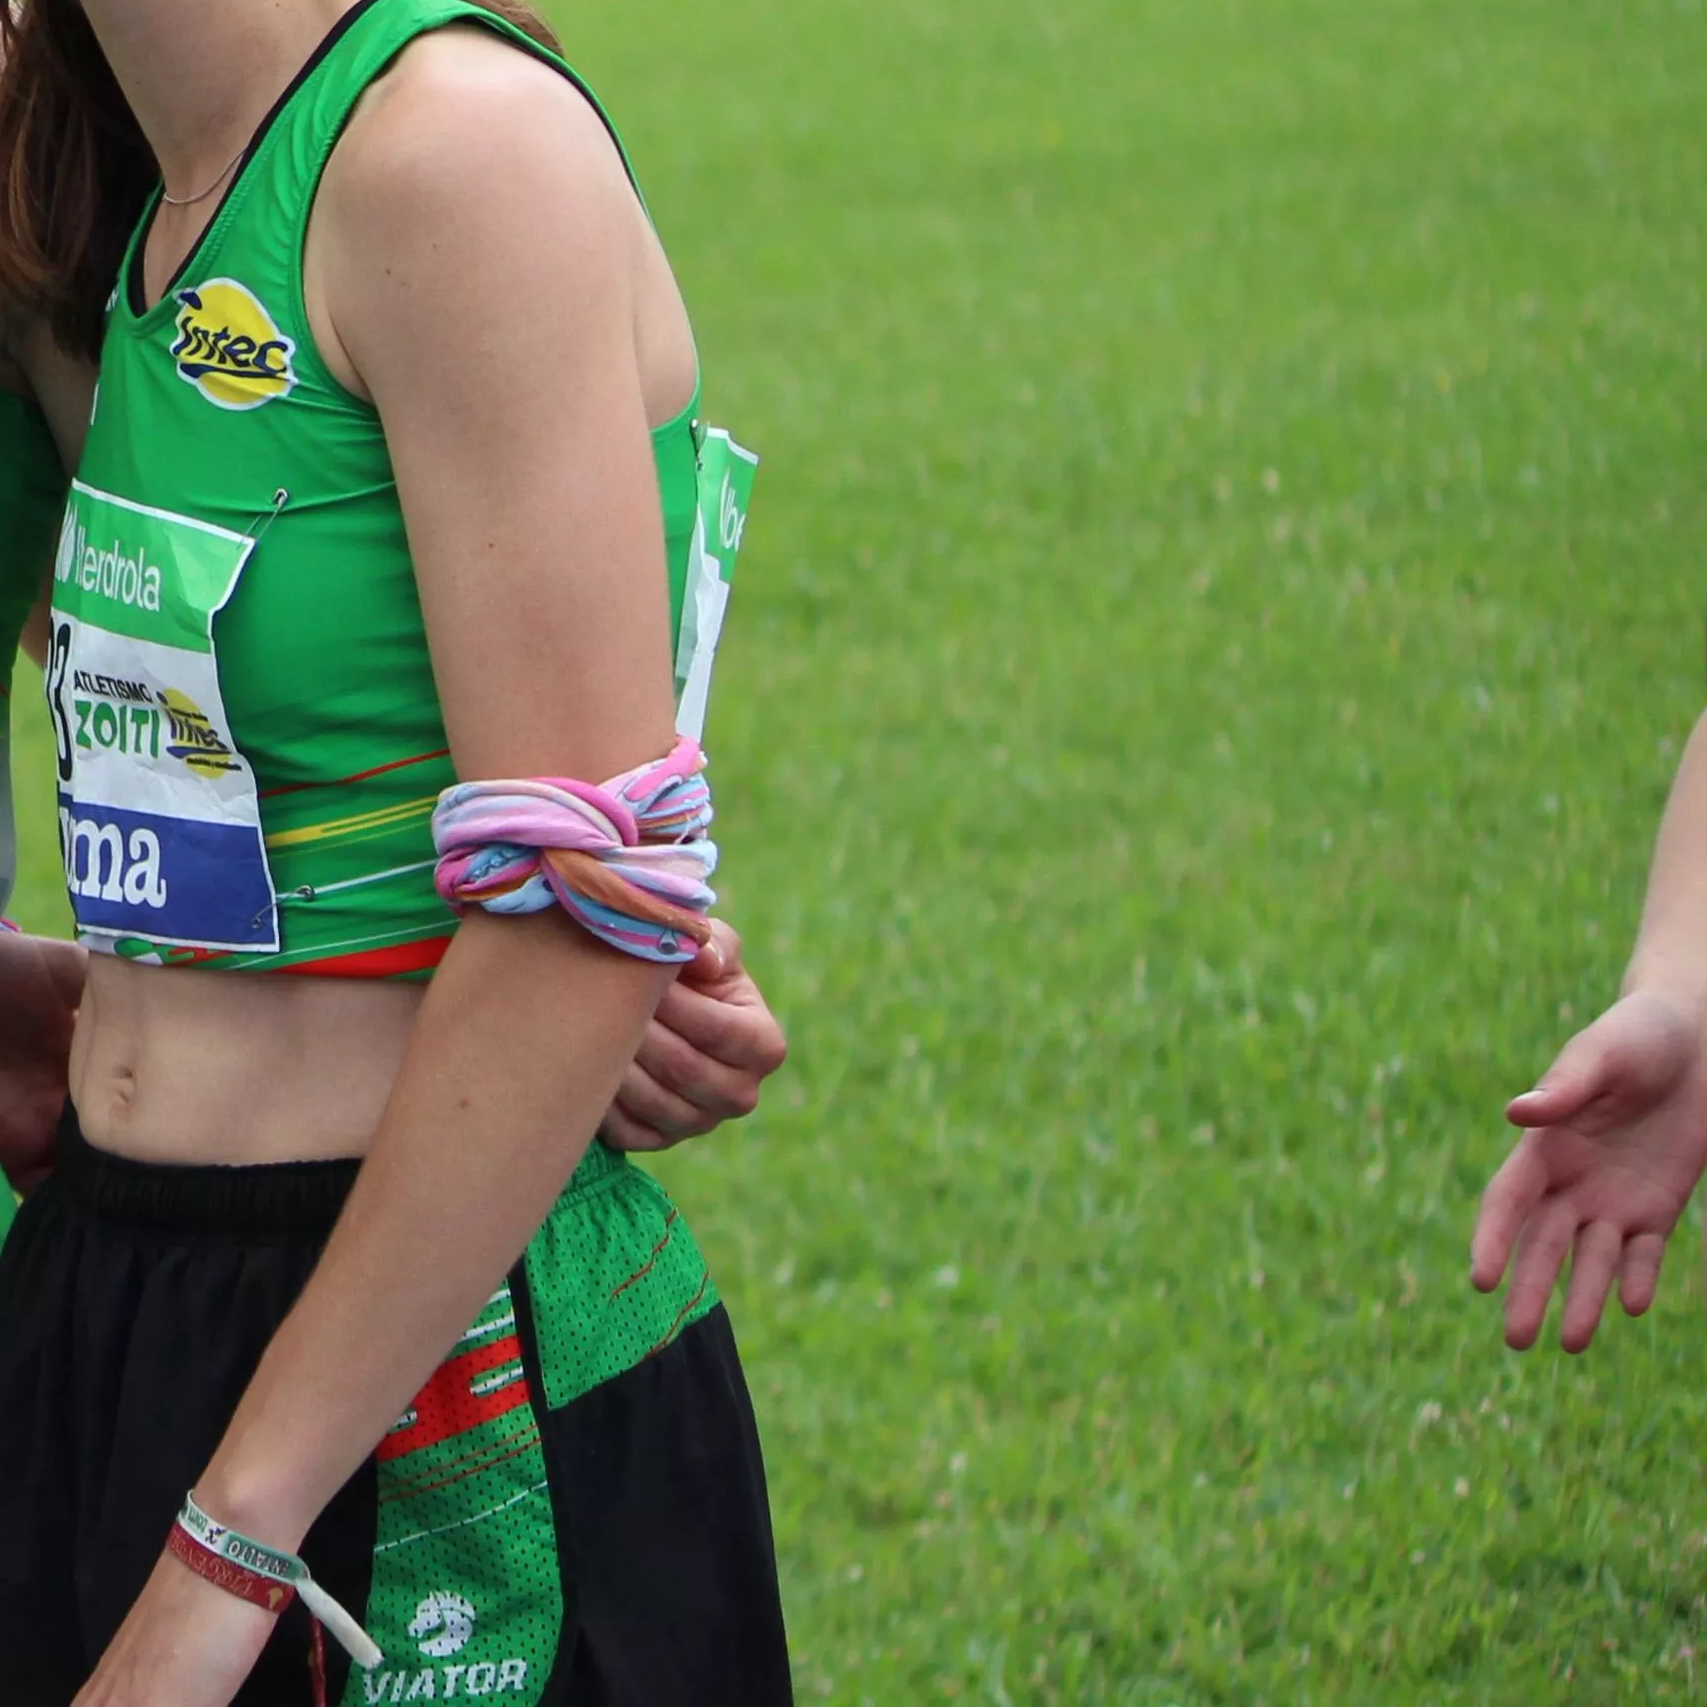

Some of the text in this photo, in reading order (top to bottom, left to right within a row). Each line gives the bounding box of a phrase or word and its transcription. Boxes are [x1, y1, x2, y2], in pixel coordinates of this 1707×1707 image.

[74, 700, 160, 759] ZOITI
[59, 807, 166, 909] ma
[361, 1657, 527, 1705] VIATOR
